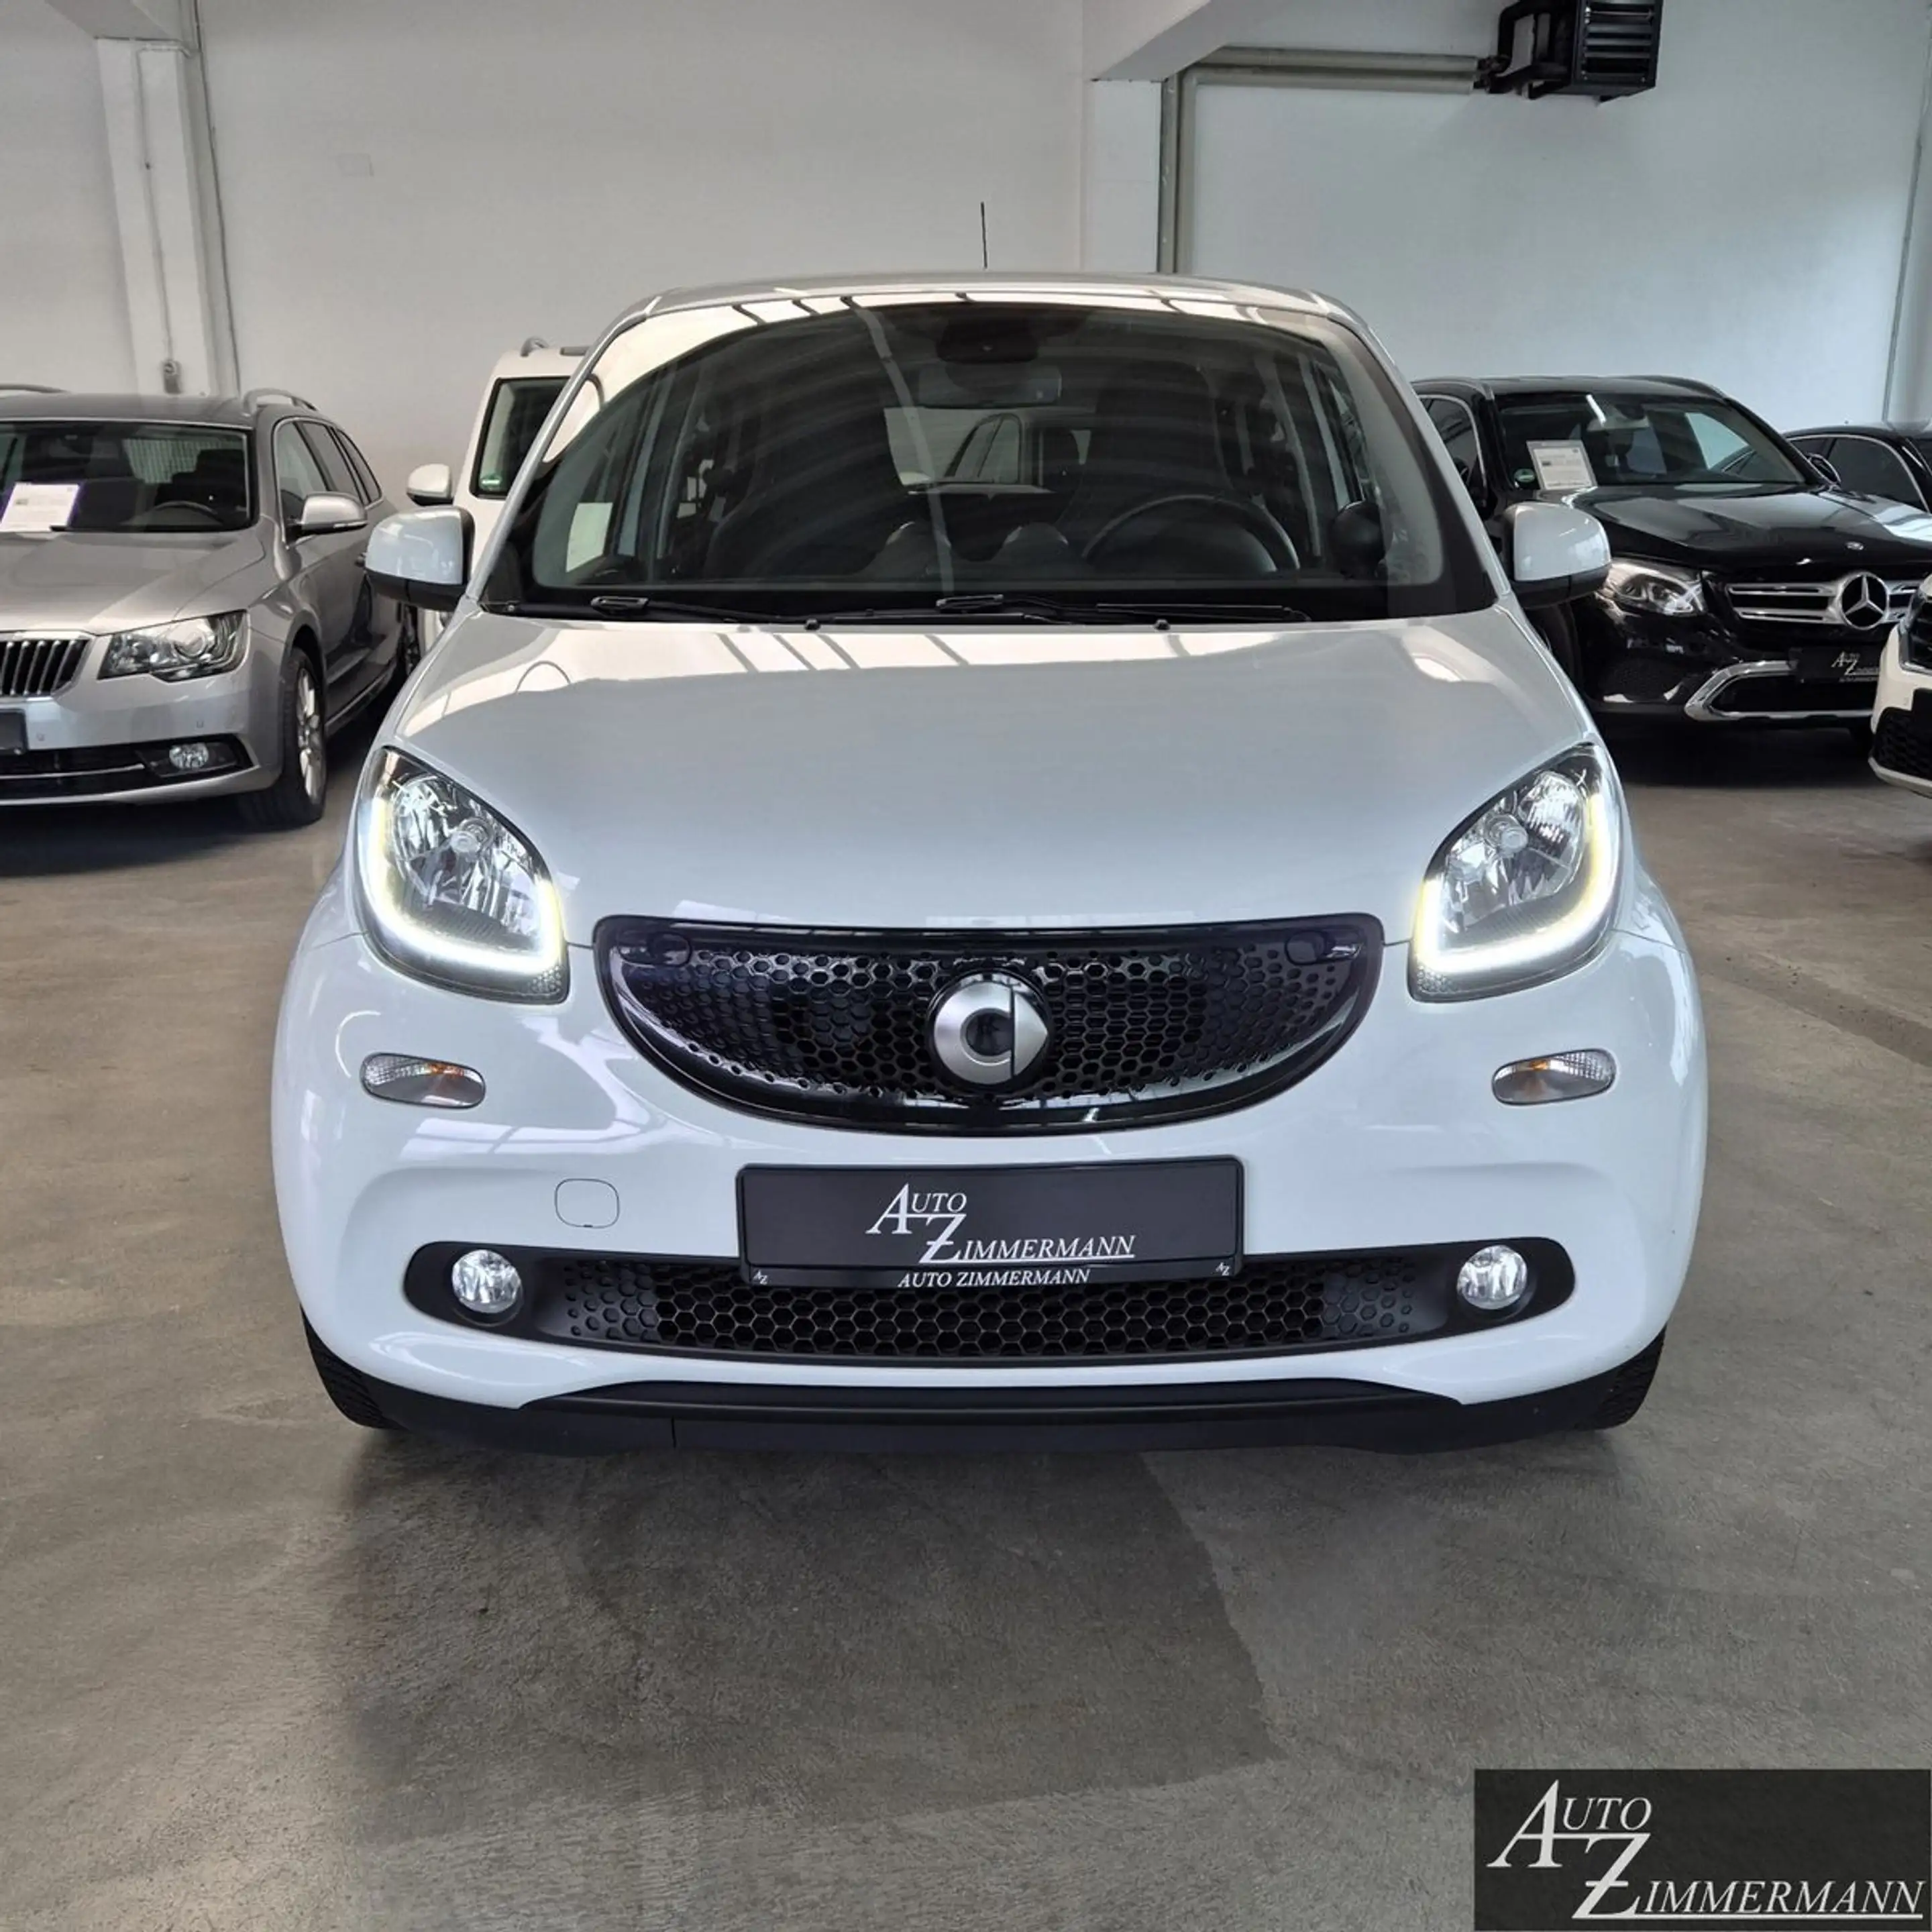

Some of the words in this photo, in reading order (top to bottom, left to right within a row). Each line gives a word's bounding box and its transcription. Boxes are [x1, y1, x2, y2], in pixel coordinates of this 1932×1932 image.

[865, 1183, 967, 1234] AUTO
[918, 1213, 1136, 1264] ZIMMERMANN
[898, 1272, 952, 1288] AUTO
[956, 1269, 1091, 1287] ZIMMERMANN
